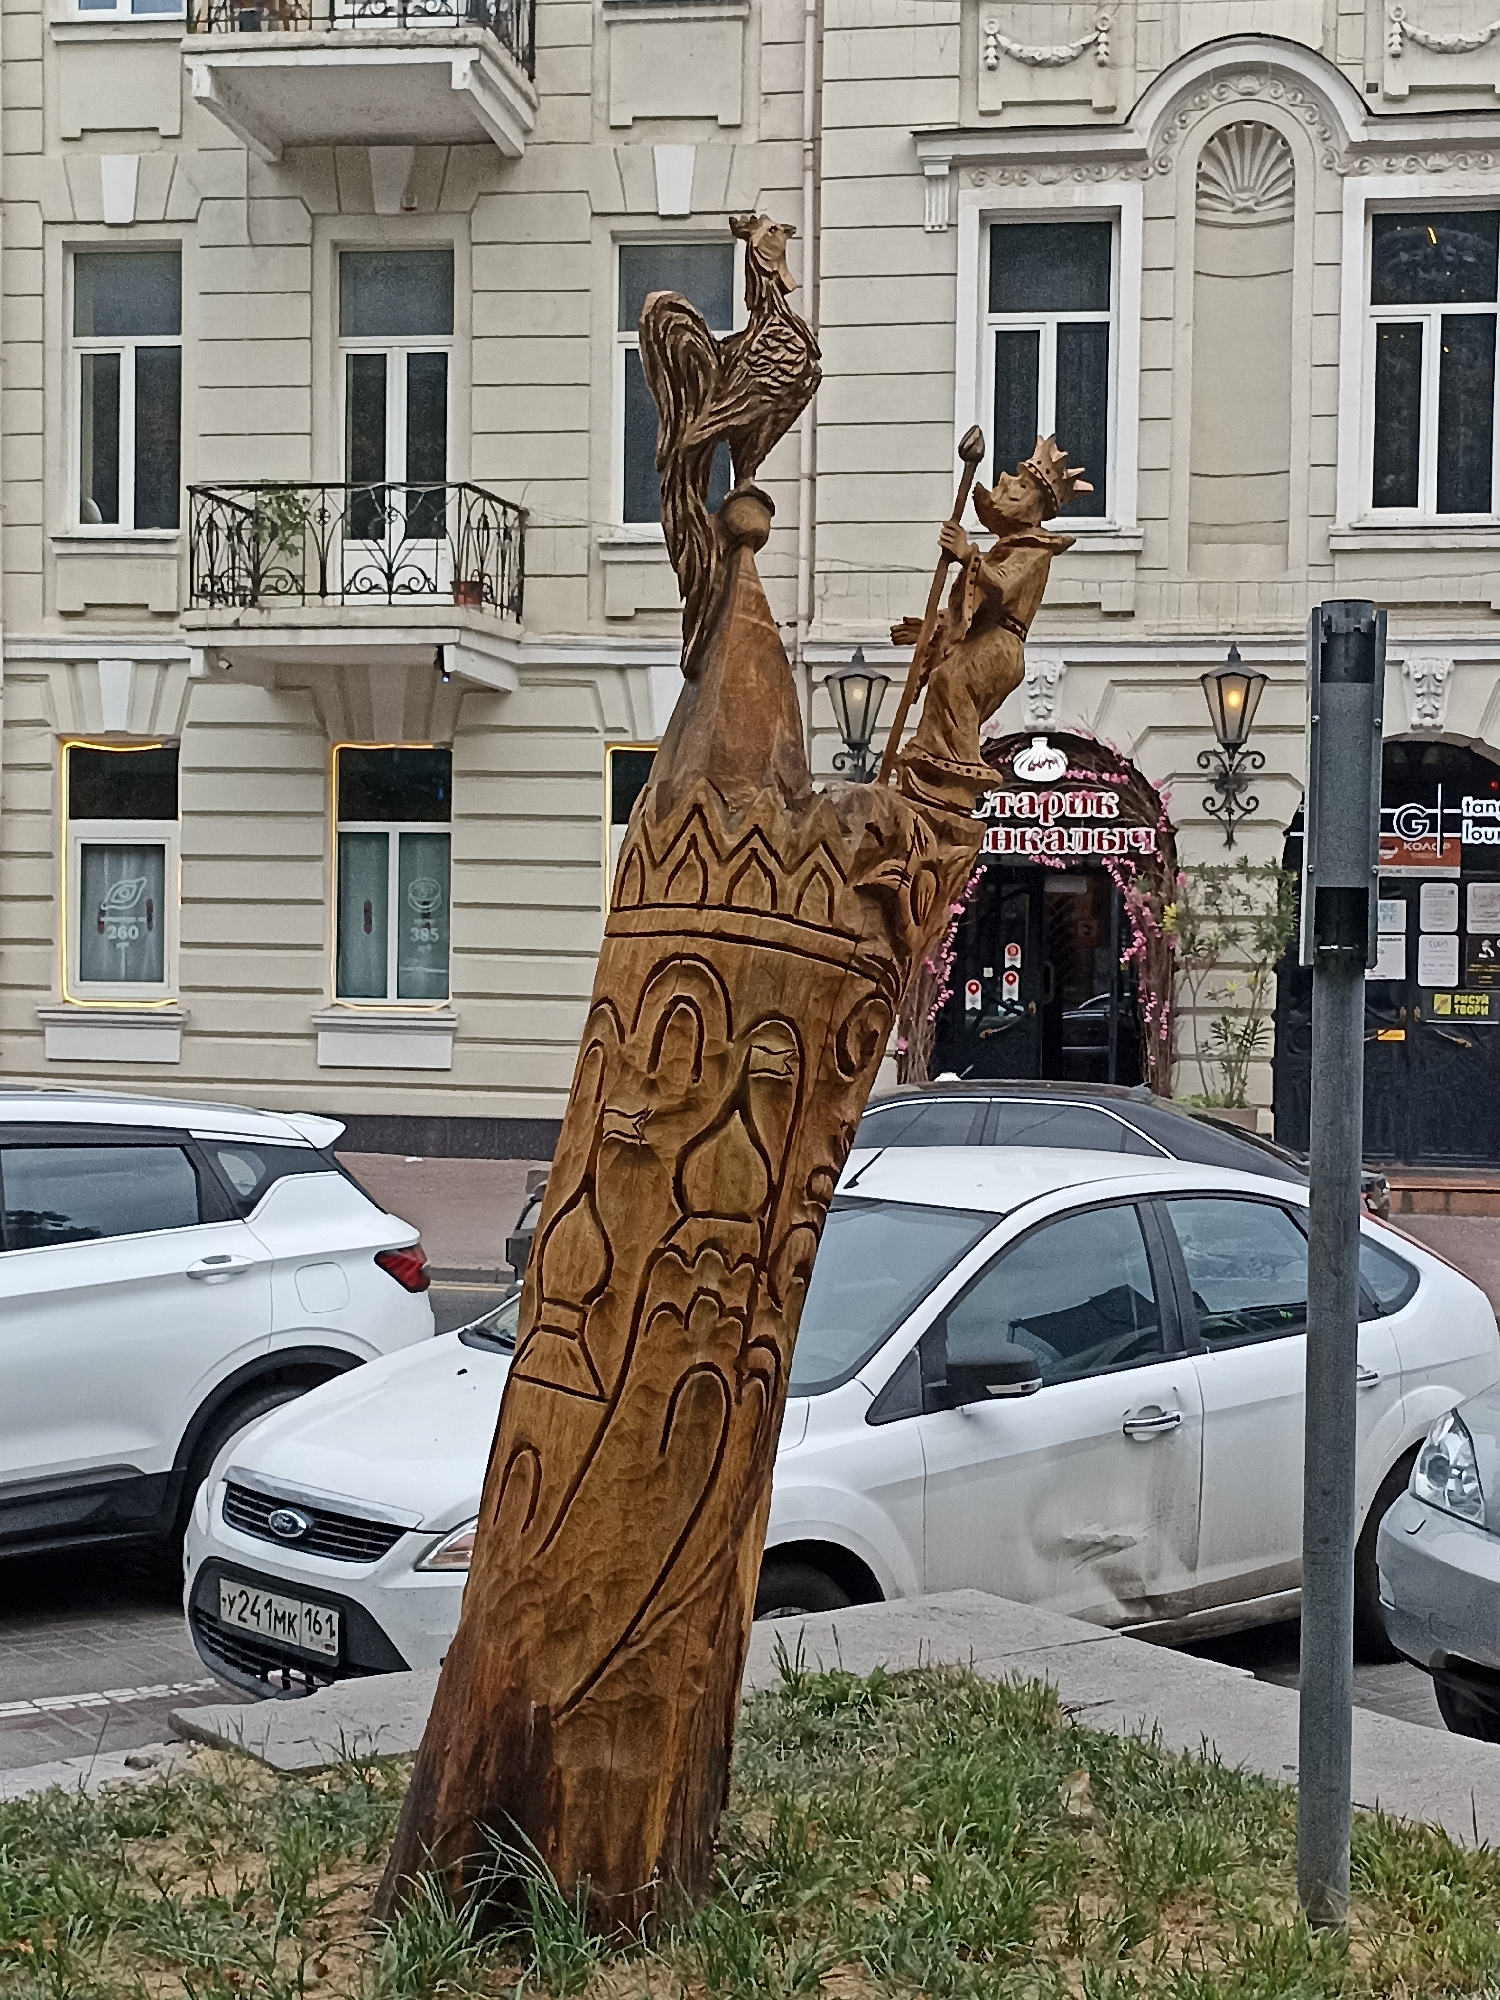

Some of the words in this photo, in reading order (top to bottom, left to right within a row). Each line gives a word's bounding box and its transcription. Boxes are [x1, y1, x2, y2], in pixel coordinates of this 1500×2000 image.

[1462, 797, 1500, 819] tan
[1393, 803, 1430, 841] G
[979, 827, 1158, 855] нкалыч
[106, 925, 139, 940] 260
[409, 926, 440, 942] 385
[1454, 1005, 1489, 1015] ТВОРИ
